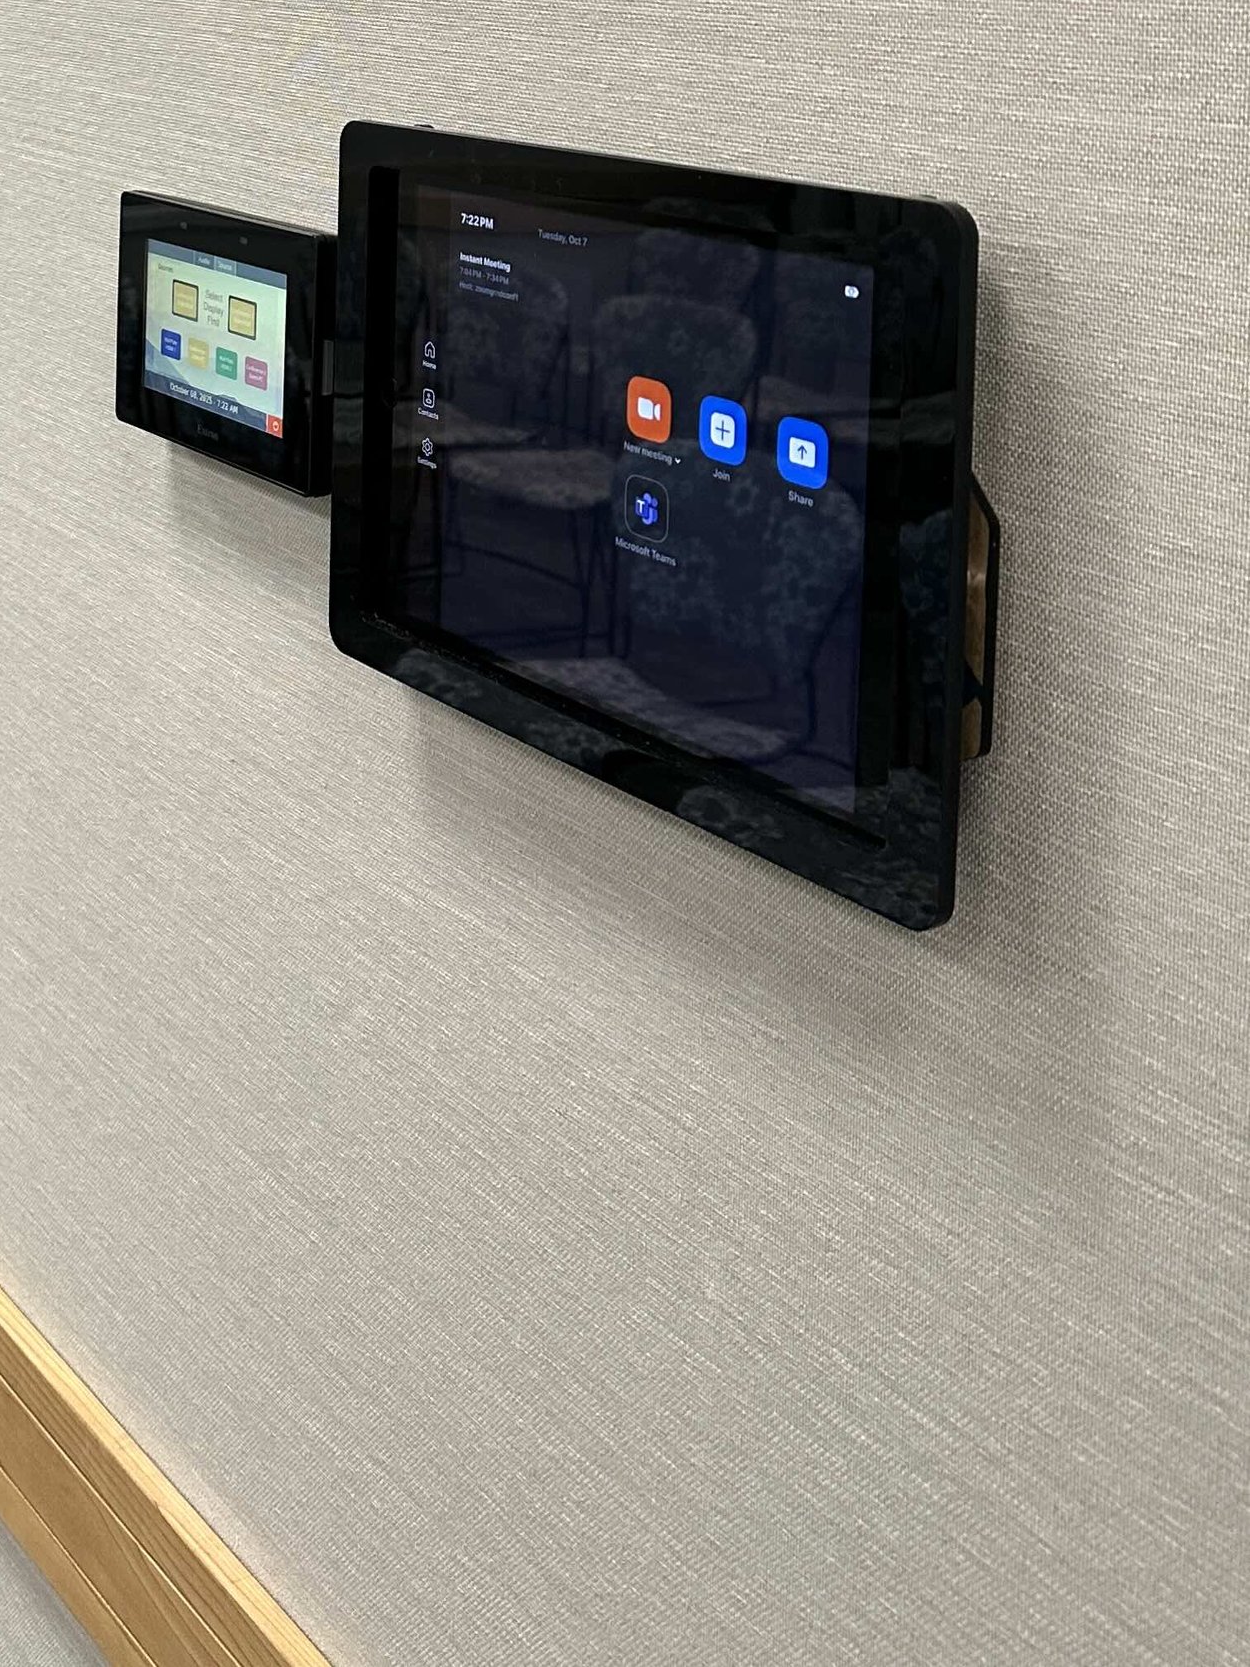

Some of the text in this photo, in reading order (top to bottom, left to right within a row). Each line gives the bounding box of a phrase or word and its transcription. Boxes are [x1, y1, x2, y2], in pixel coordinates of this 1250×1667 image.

[538, 228, 588, 247] Tuesday, Oct 7
[459, 252, 511, 273] Instant Meeting
[623, 441, 673, 466] New meeting
[713, 468, 731, 482] Join
[788, 490, 814, 508] Share
[615, 536, 677, 567] Microsoft Teams
